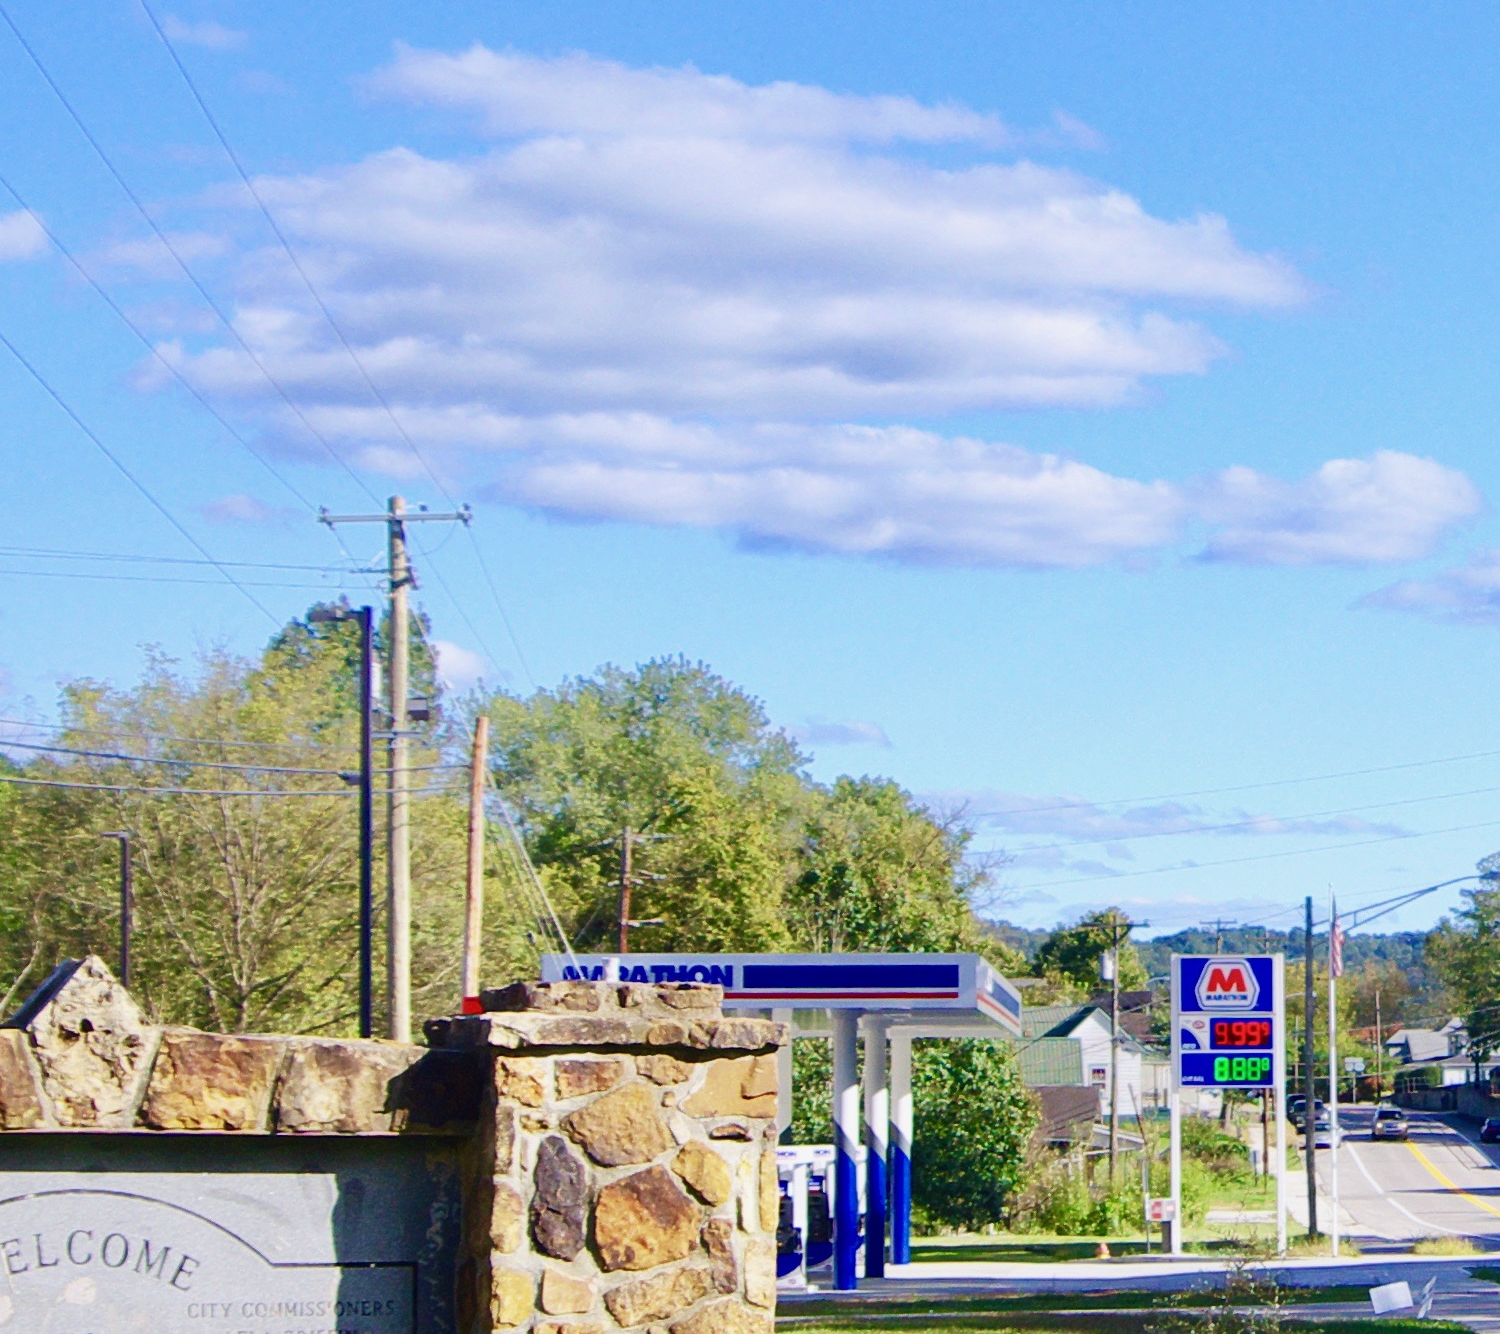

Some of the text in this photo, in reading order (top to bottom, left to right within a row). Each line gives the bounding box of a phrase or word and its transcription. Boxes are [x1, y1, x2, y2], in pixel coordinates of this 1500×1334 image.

[1206, 968, 1247, 992] M
[187, 1299, 395, 1318] CITY COMMISSONERS
